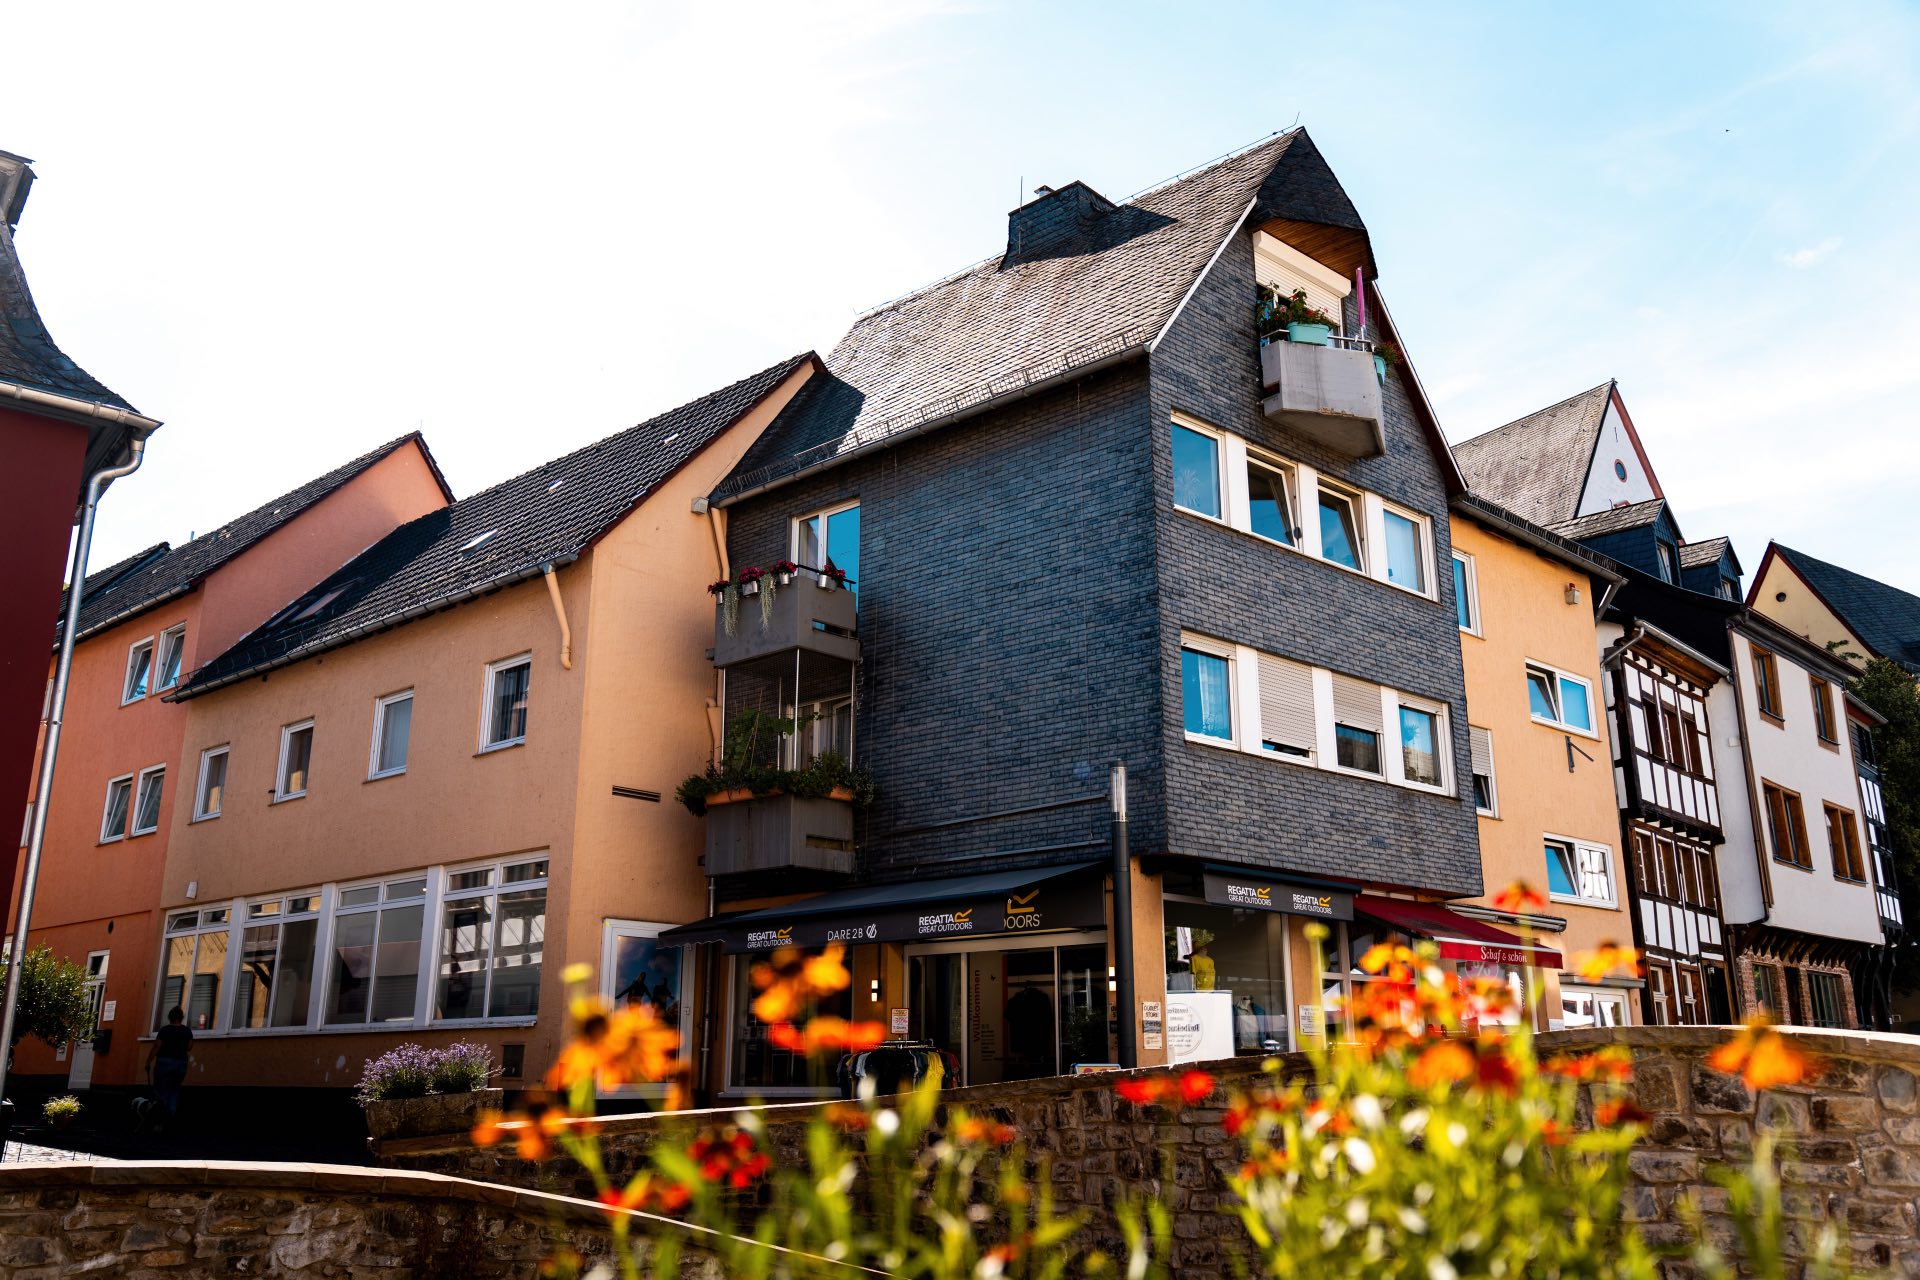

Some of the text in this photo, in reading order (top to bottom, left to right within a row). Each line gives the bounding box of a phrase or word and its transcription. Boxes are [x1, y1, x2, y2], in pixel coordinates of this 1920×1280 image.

[1228, 885, 1257, 897] REGATTA
[1228, 895, 1272, 907] GREAT OUTDOORS
[1292, 894, 1319, 905] REGATTA
[1308, 904, 1333, 914] OUTDOORS
[919, 914, 954, 926] REGATTA
[1004, 914, 1040, 929] OORS
[827, 927, 864, 941] DARE 2B
[918, 922, 973, 934] GREAT OUTDOORS
[747, 931, 777, 942] REGATTA
[747, 938, 793, 949] GREAT OUTDOORS
[1481, 946, 1502, 963] Schaf
[973, 969, 981, 1042] Willkommen
